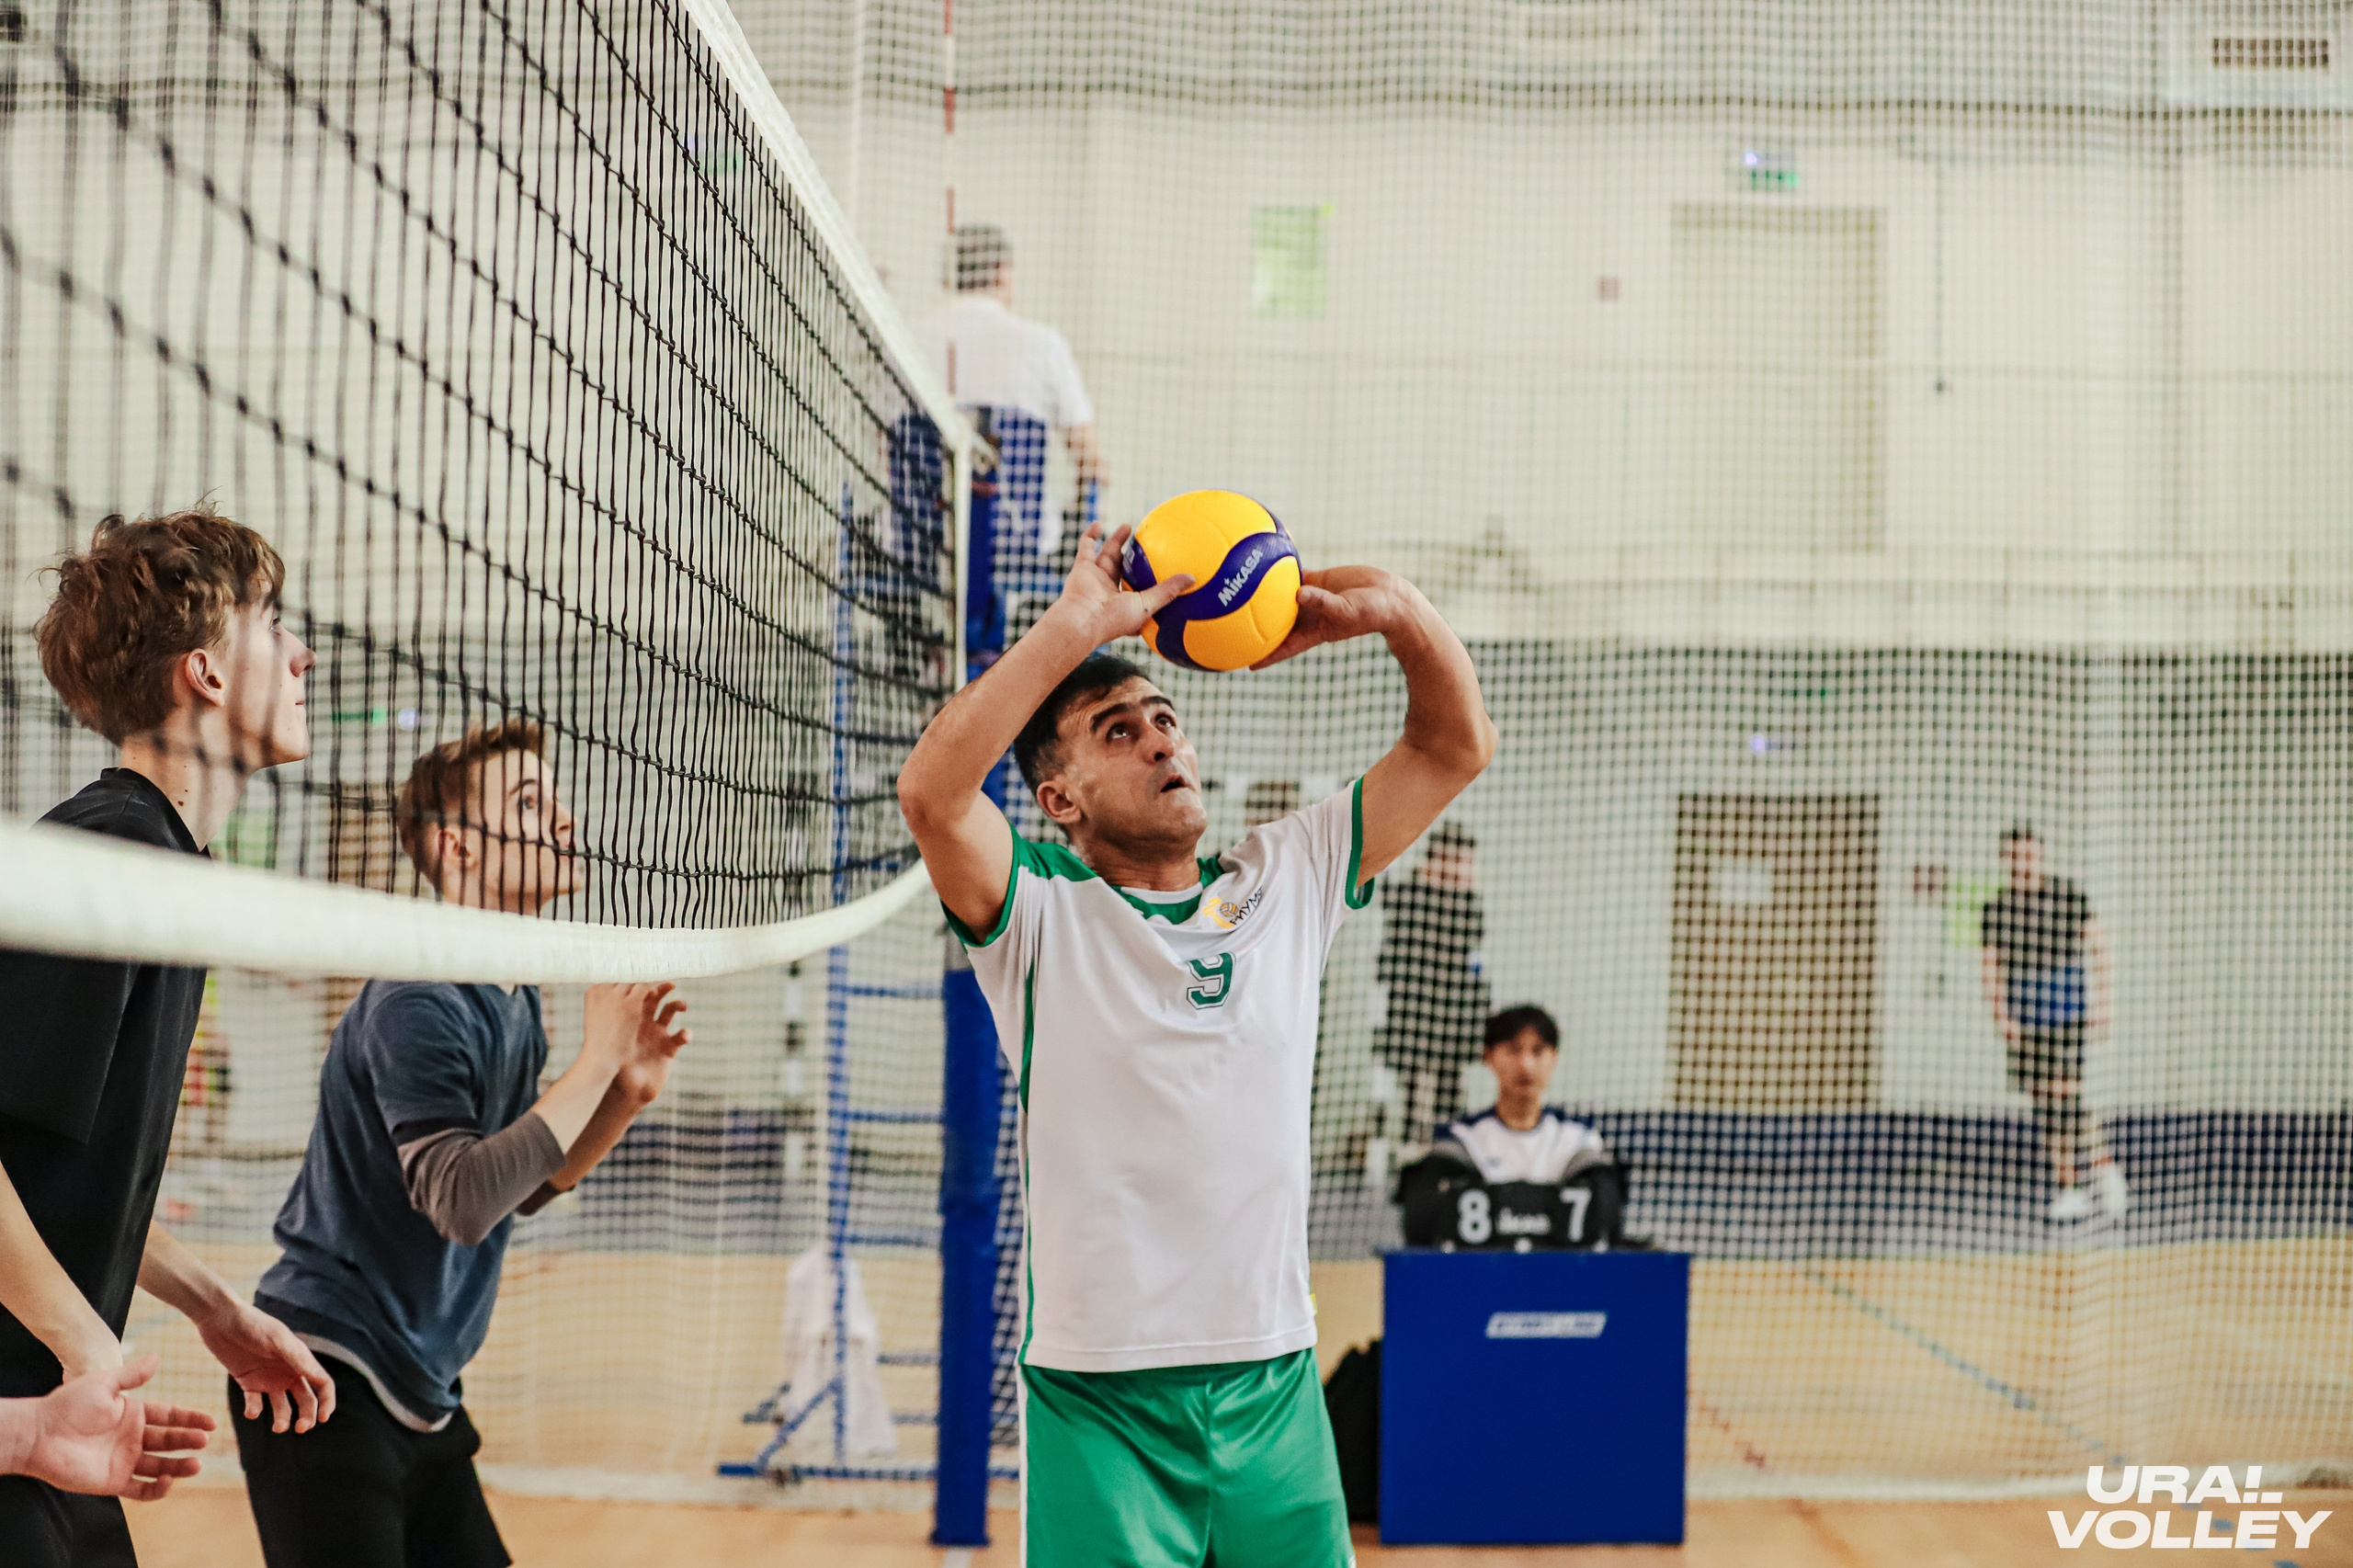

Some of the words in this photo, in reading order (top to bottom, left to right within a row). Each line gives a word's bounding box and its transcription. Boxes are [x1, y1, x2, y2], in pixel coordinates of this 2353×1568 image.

[1186, 952, 1236, 1010] 9
[1458, 1189, 1493, 1244] 8
[1560, 1187, 1592, 1242] 7
